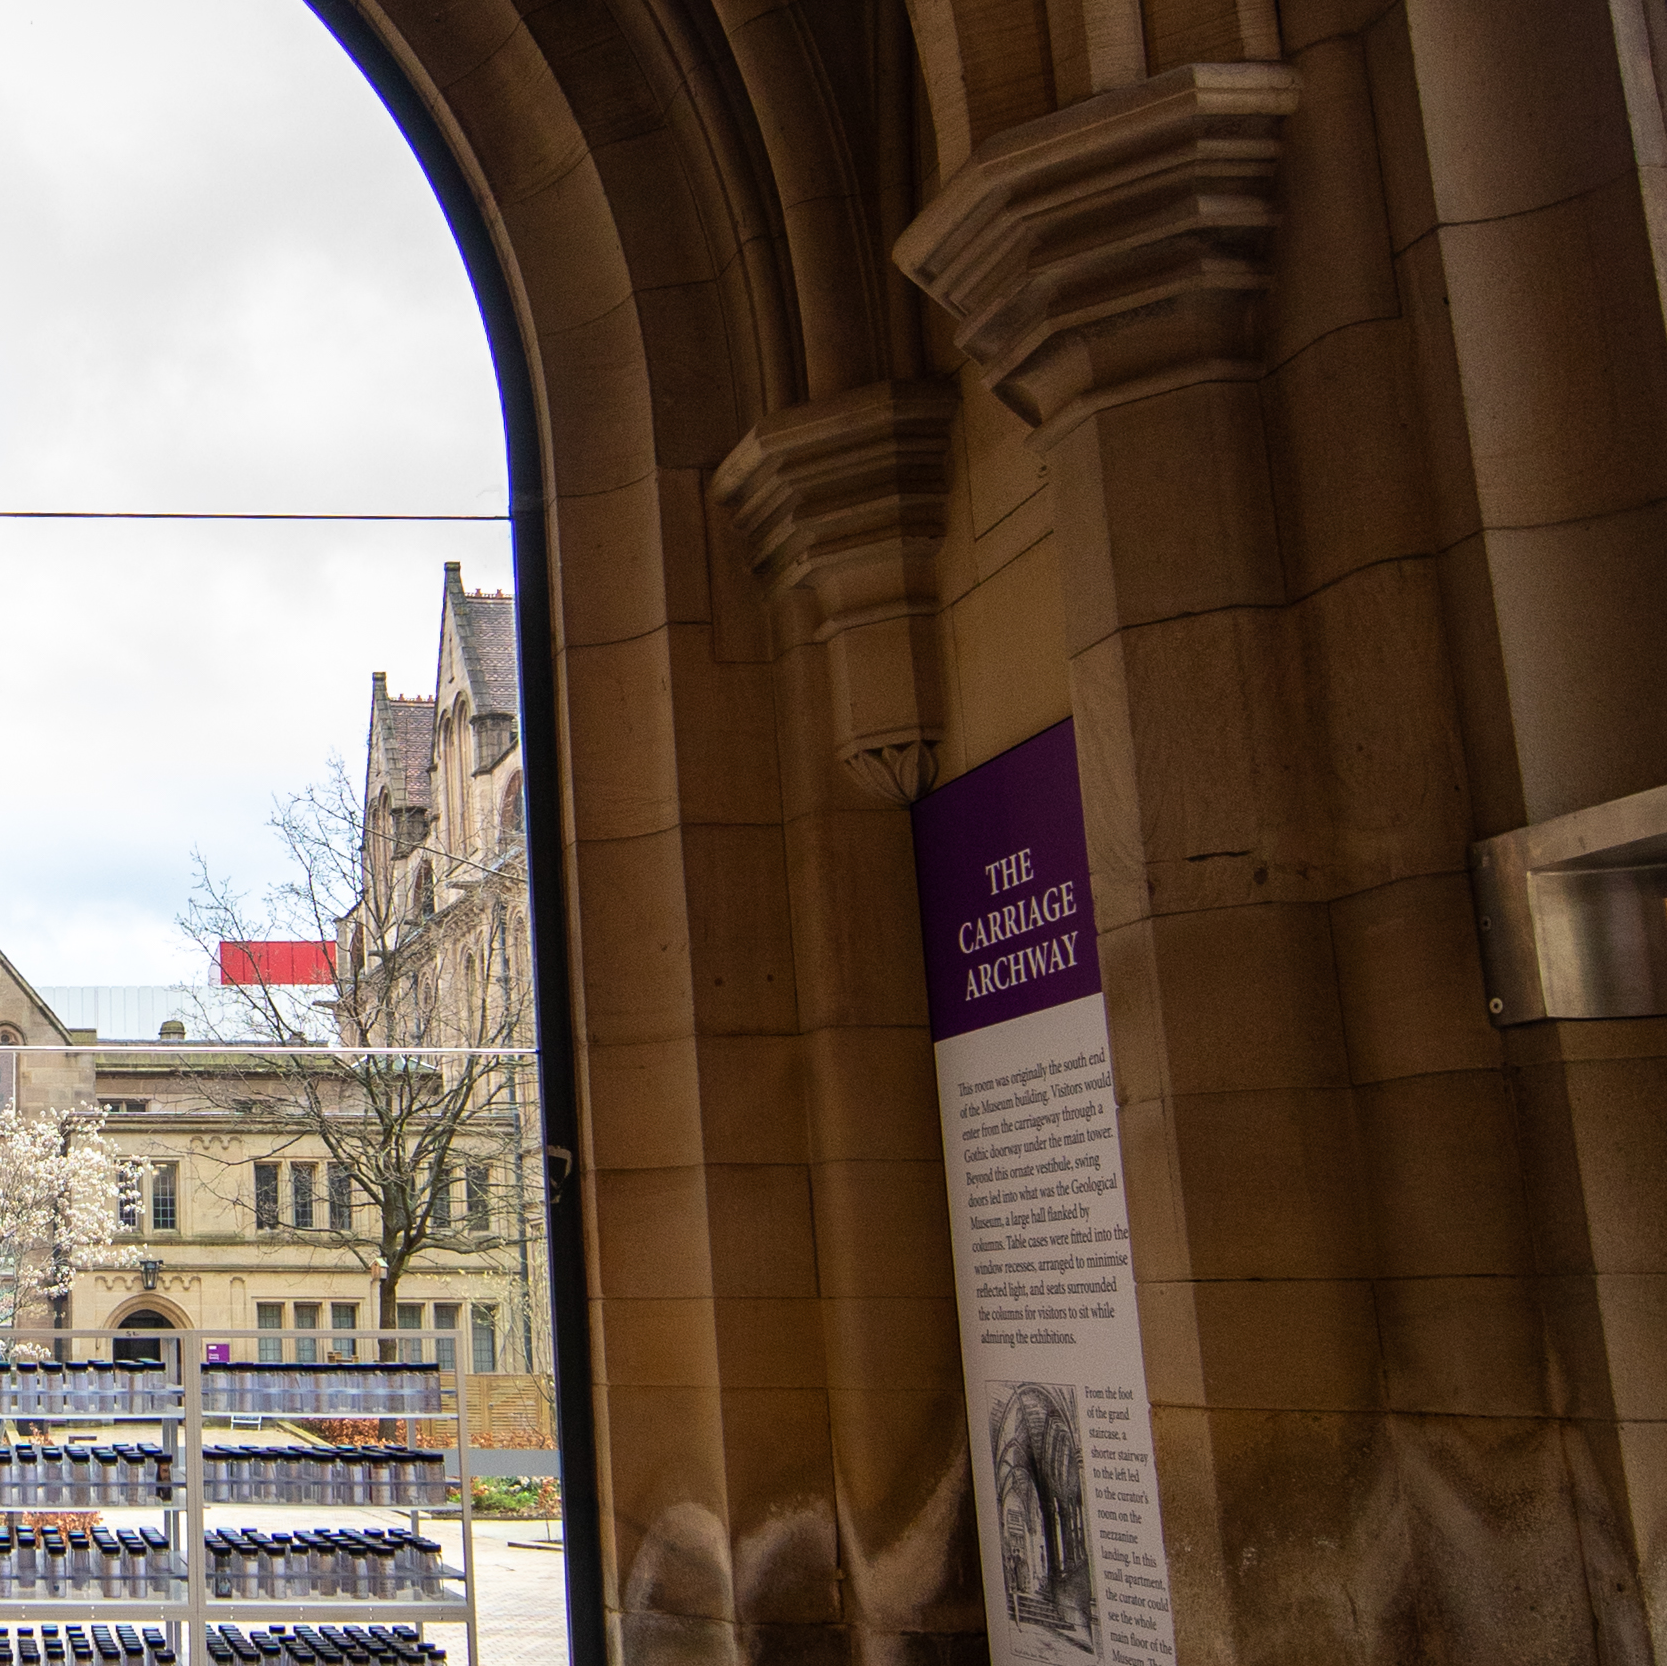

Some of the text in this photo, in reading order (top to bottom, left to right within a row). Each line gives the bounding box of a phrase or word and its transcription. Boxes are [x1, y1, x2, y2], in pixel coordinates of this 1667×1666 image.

[985, 847, 1033, 895] THE
[958, 880, 1076, 953] CARRIAGE
[965, 930, 1078, 1001] ARCHWAY
[958, 1046, 1105, 1097] This room was originally the south end
[959, 1070, 1111, 1119] of the Museum building. Visitors would
[963, 1127, 1113, 1163] Gothic doorway under the main tower.
[966, 1172, 1117, 1208] doors led into what was the Geological
[971, 1223, 1128, 1253] columns. Table cases were fitted into the
[980, 1328, 1076, 1348] admiring the exhibitions.
[1090, 1444, 1148, 1466] shorter stairway
[1109, 1631, 1172, 1655] main floor of the
